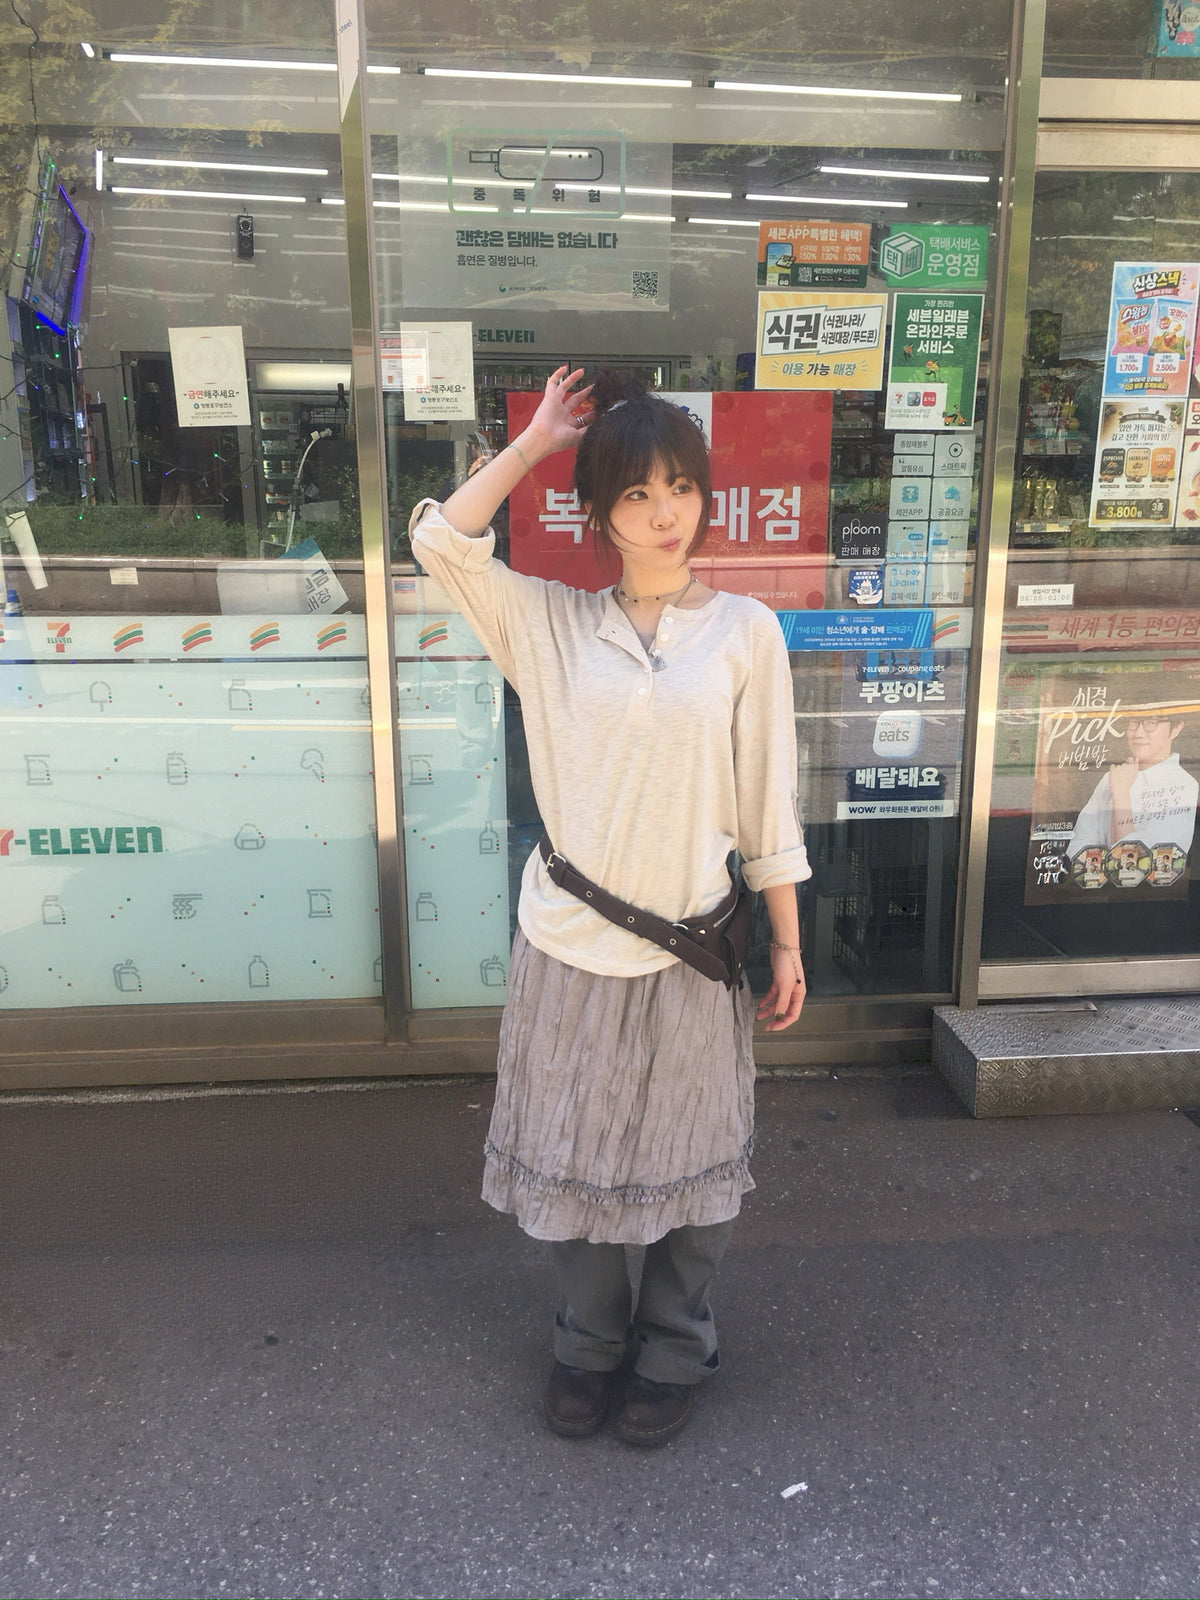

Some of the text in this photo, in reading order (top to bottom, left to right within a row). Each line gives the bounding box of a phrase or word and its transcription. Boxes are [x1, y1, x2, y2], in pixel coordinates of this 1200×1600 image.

[456, 229, 618, 249] 괜찮은 담배는 없습니다
[929, 237, 981, 251] 택배서비스
[456, 254, 538, 268] 흡연은 질병입니다.
[927, 252, 980, 277] 운영점
[906, 308, 969, 324] 세븐일레븐
[766, 313, 821, 351] 식권
[905, 324, 969, 339] 온라인주문
[917, 340, 955, 354] 서비스
[782, 362, 857, 376] 이용 가능 매장
[842, 518, 881, 544] ploom
[862, 546, 881, 556] 매장
[825, 625, 860, 635] 청소년에게
[1059, 613, 1200, 639] 세계 1등 편의점
[859, 680, 946, 704] 쿠팡이츠
[1072, 686, 1108, 708] 시경
[1044, 699, 1126, 753] Pick
[879, 728, 910, 742] eats
[855, 766, 940, 789] 배달돼요
[848, 806, 877, 814] WOW!
